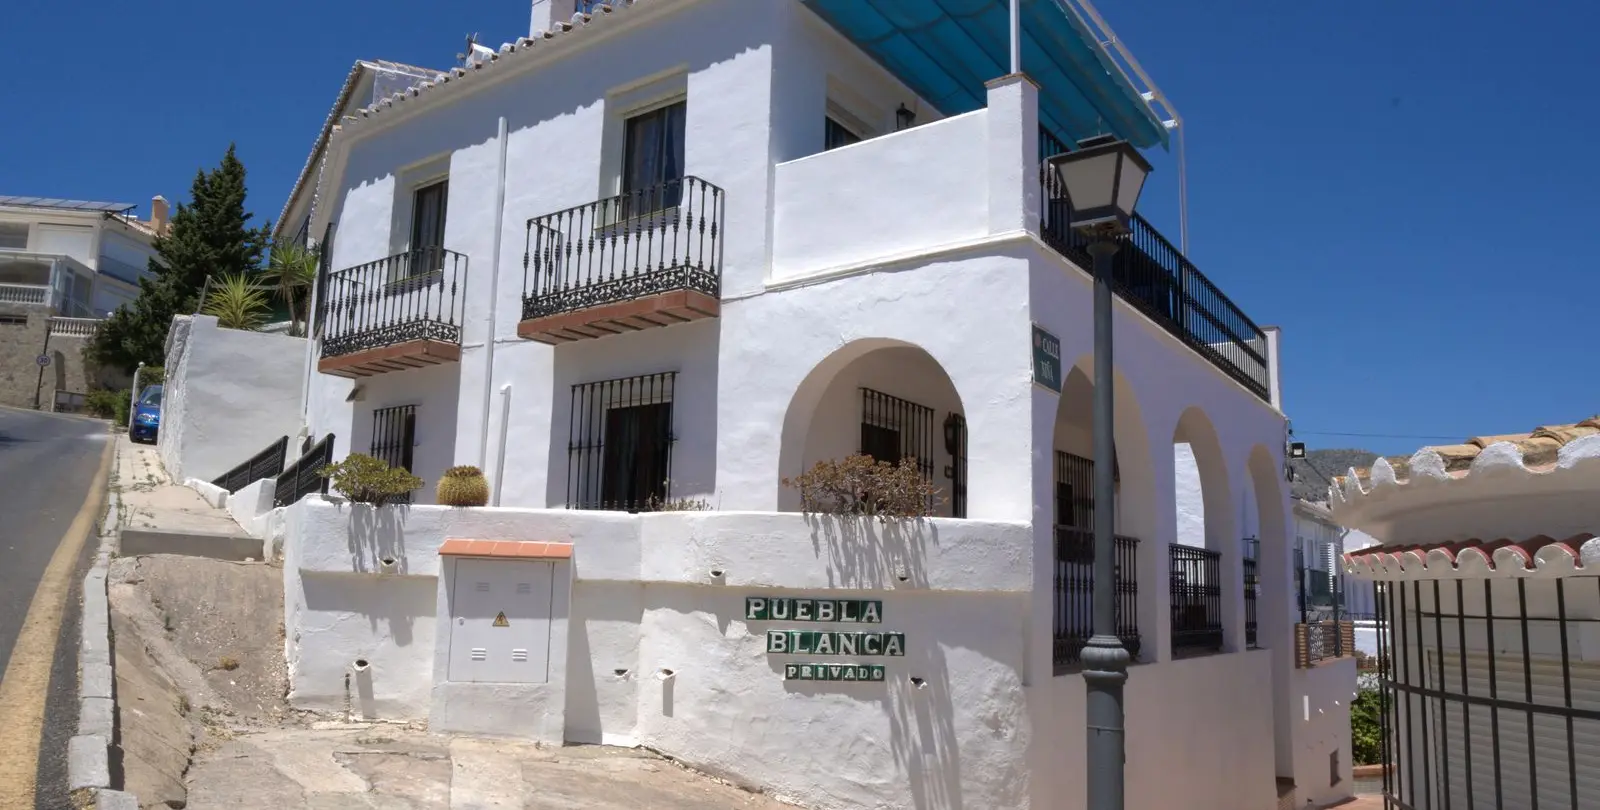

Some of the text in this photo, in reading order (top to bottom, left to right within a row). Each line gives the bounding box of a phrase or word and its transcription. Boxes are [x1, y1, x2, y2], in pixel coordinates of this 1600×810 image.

[747, 598, 880, 622] PUEBLA
[769, 632, 903, 655] BLANCA
[787, 667, 883, 679] PRIVADO
